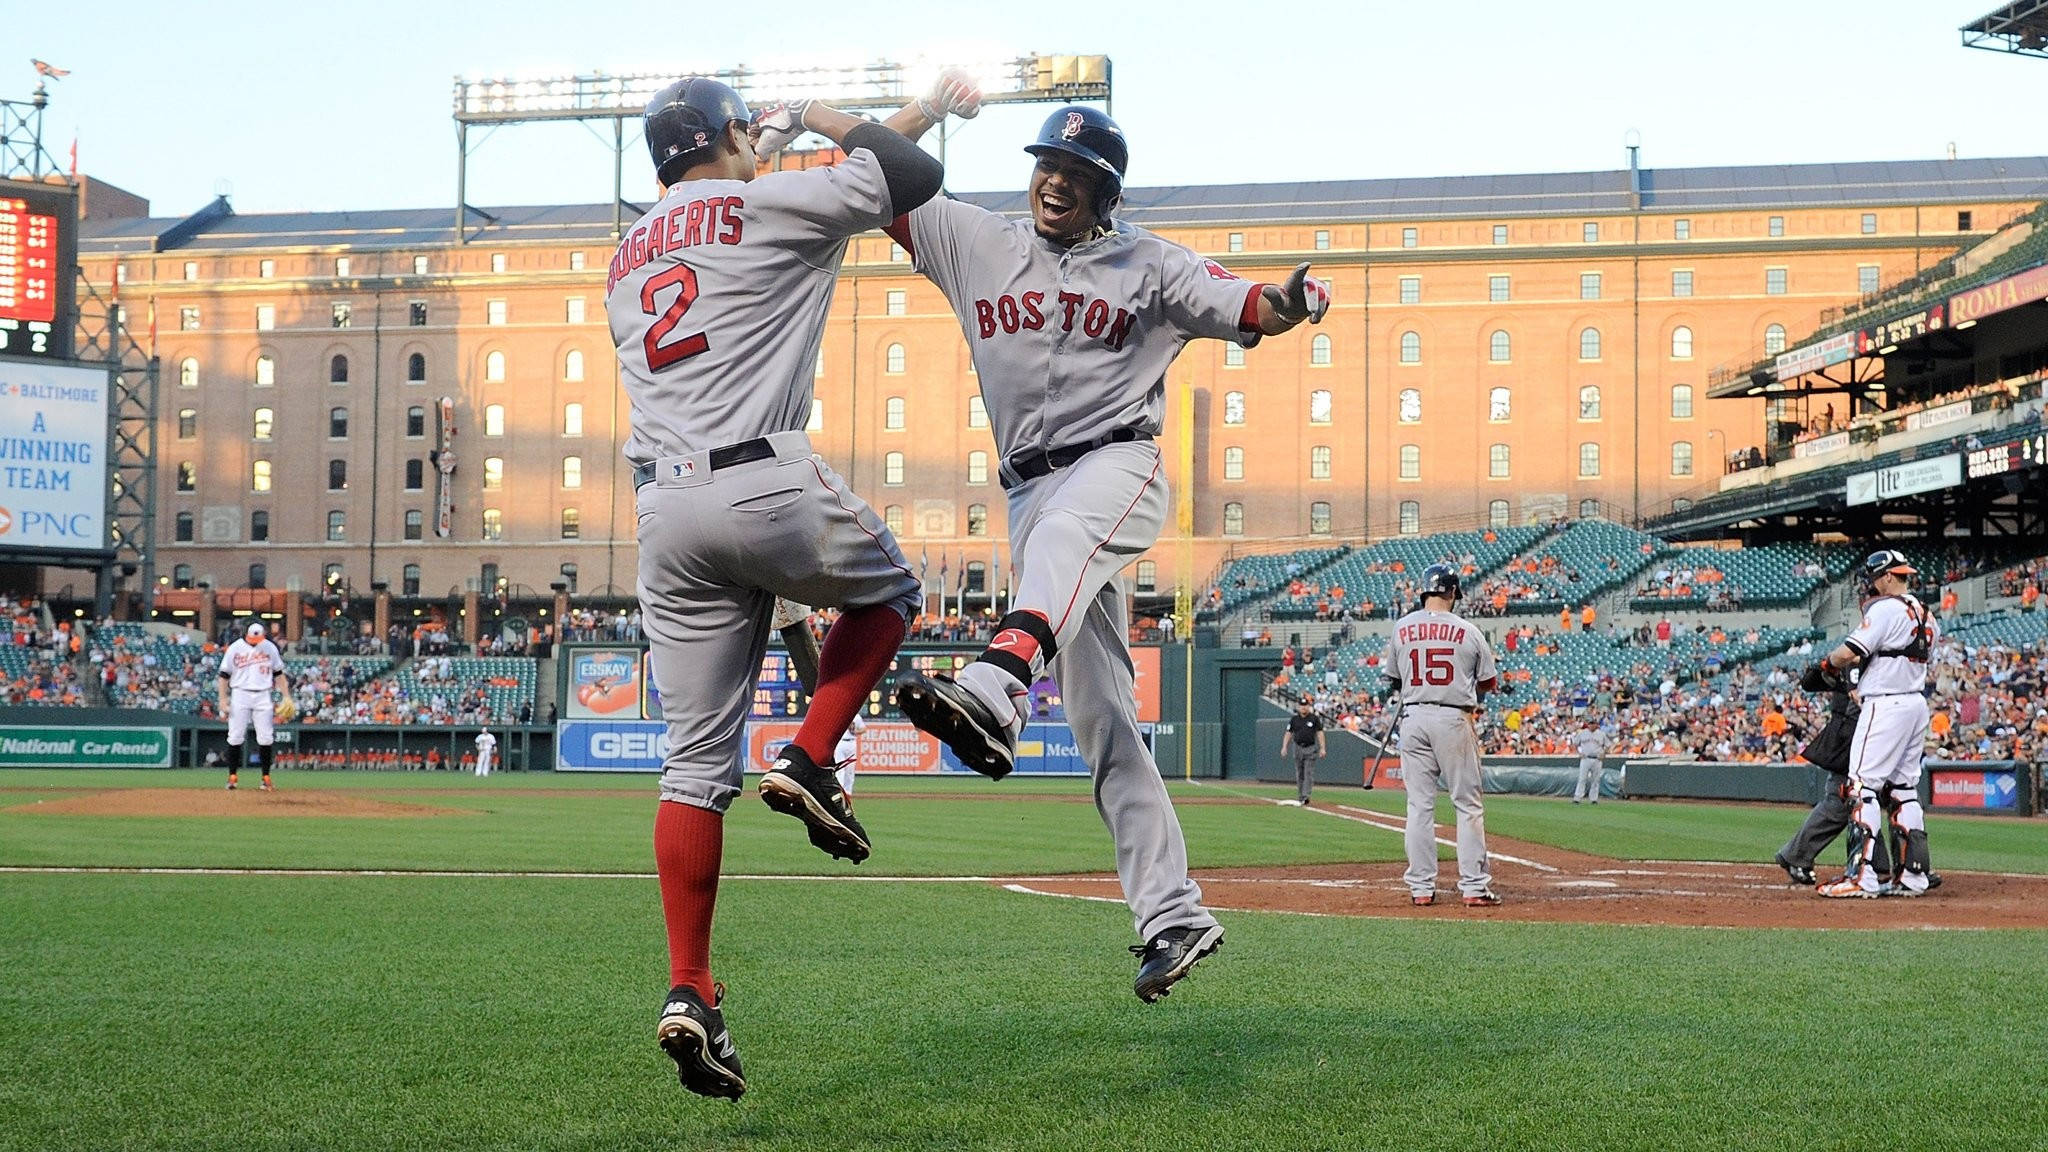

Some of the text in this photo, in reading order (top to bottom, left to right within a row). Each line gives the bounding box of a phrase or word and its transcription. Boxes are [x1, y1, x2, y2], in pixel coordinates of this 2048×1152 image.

[694, 131, 709, 147] 2
[607, 196, 744, 298] BOGAERTS
[1951, 280, 2018, 321] ROMA
[640, 262, 711, 374] 2
[975, 290, 1137, 351] BOSTON
[31, 332, 46, 352] 2
[20, 383, 98, 402] BALTIMORE
[32, 411, 46, 433] A
[6, 467, 71, 491] TEAM
[1968, 459, 2009, 478] ORIOLES
[21, 511, 92, 538] PNC
[1399, 623, 1466, 645] PEDROIA
[581, 662, 628, 677] ESSKAY
[1409, 648, 1455, 686] 15
[862, 729, 919, 741] HEATING
[2, 738, 160, 755] National Car Rental
[862, 741, 929, 755] PLUMBING
[862, 754, 920, 767] COOLING
